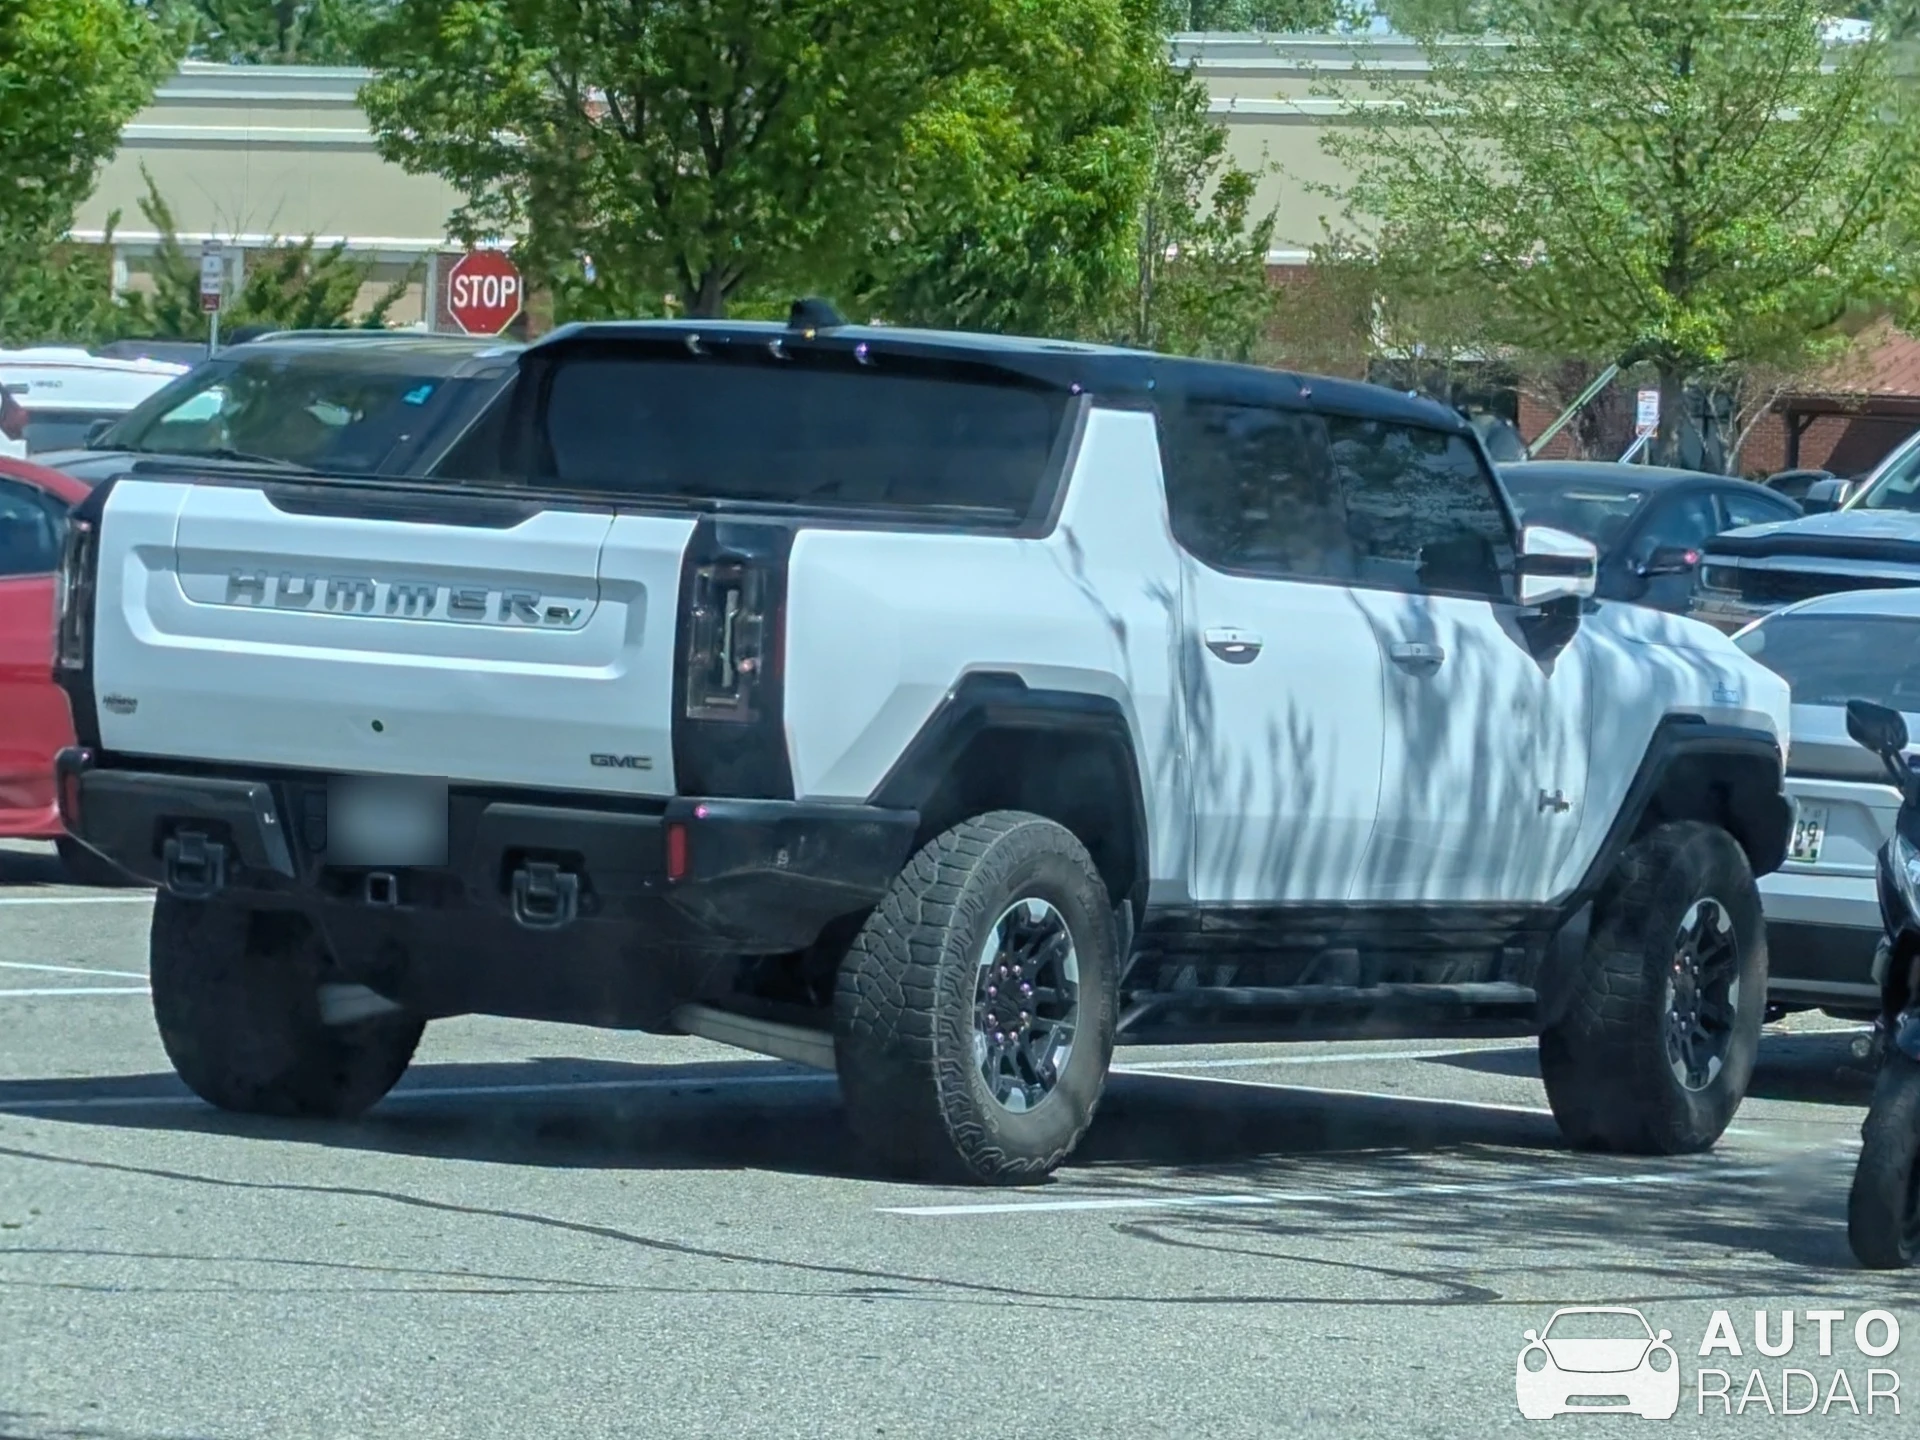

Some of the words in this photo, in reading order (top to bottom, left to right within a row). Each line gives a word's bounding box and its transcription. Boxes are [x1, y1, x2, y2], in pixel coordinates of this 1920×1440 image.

[453, 274, 516, 308] STOP
[227, 567, 542, 624] HUMMER
[590, 754, 652, 770] GMC
